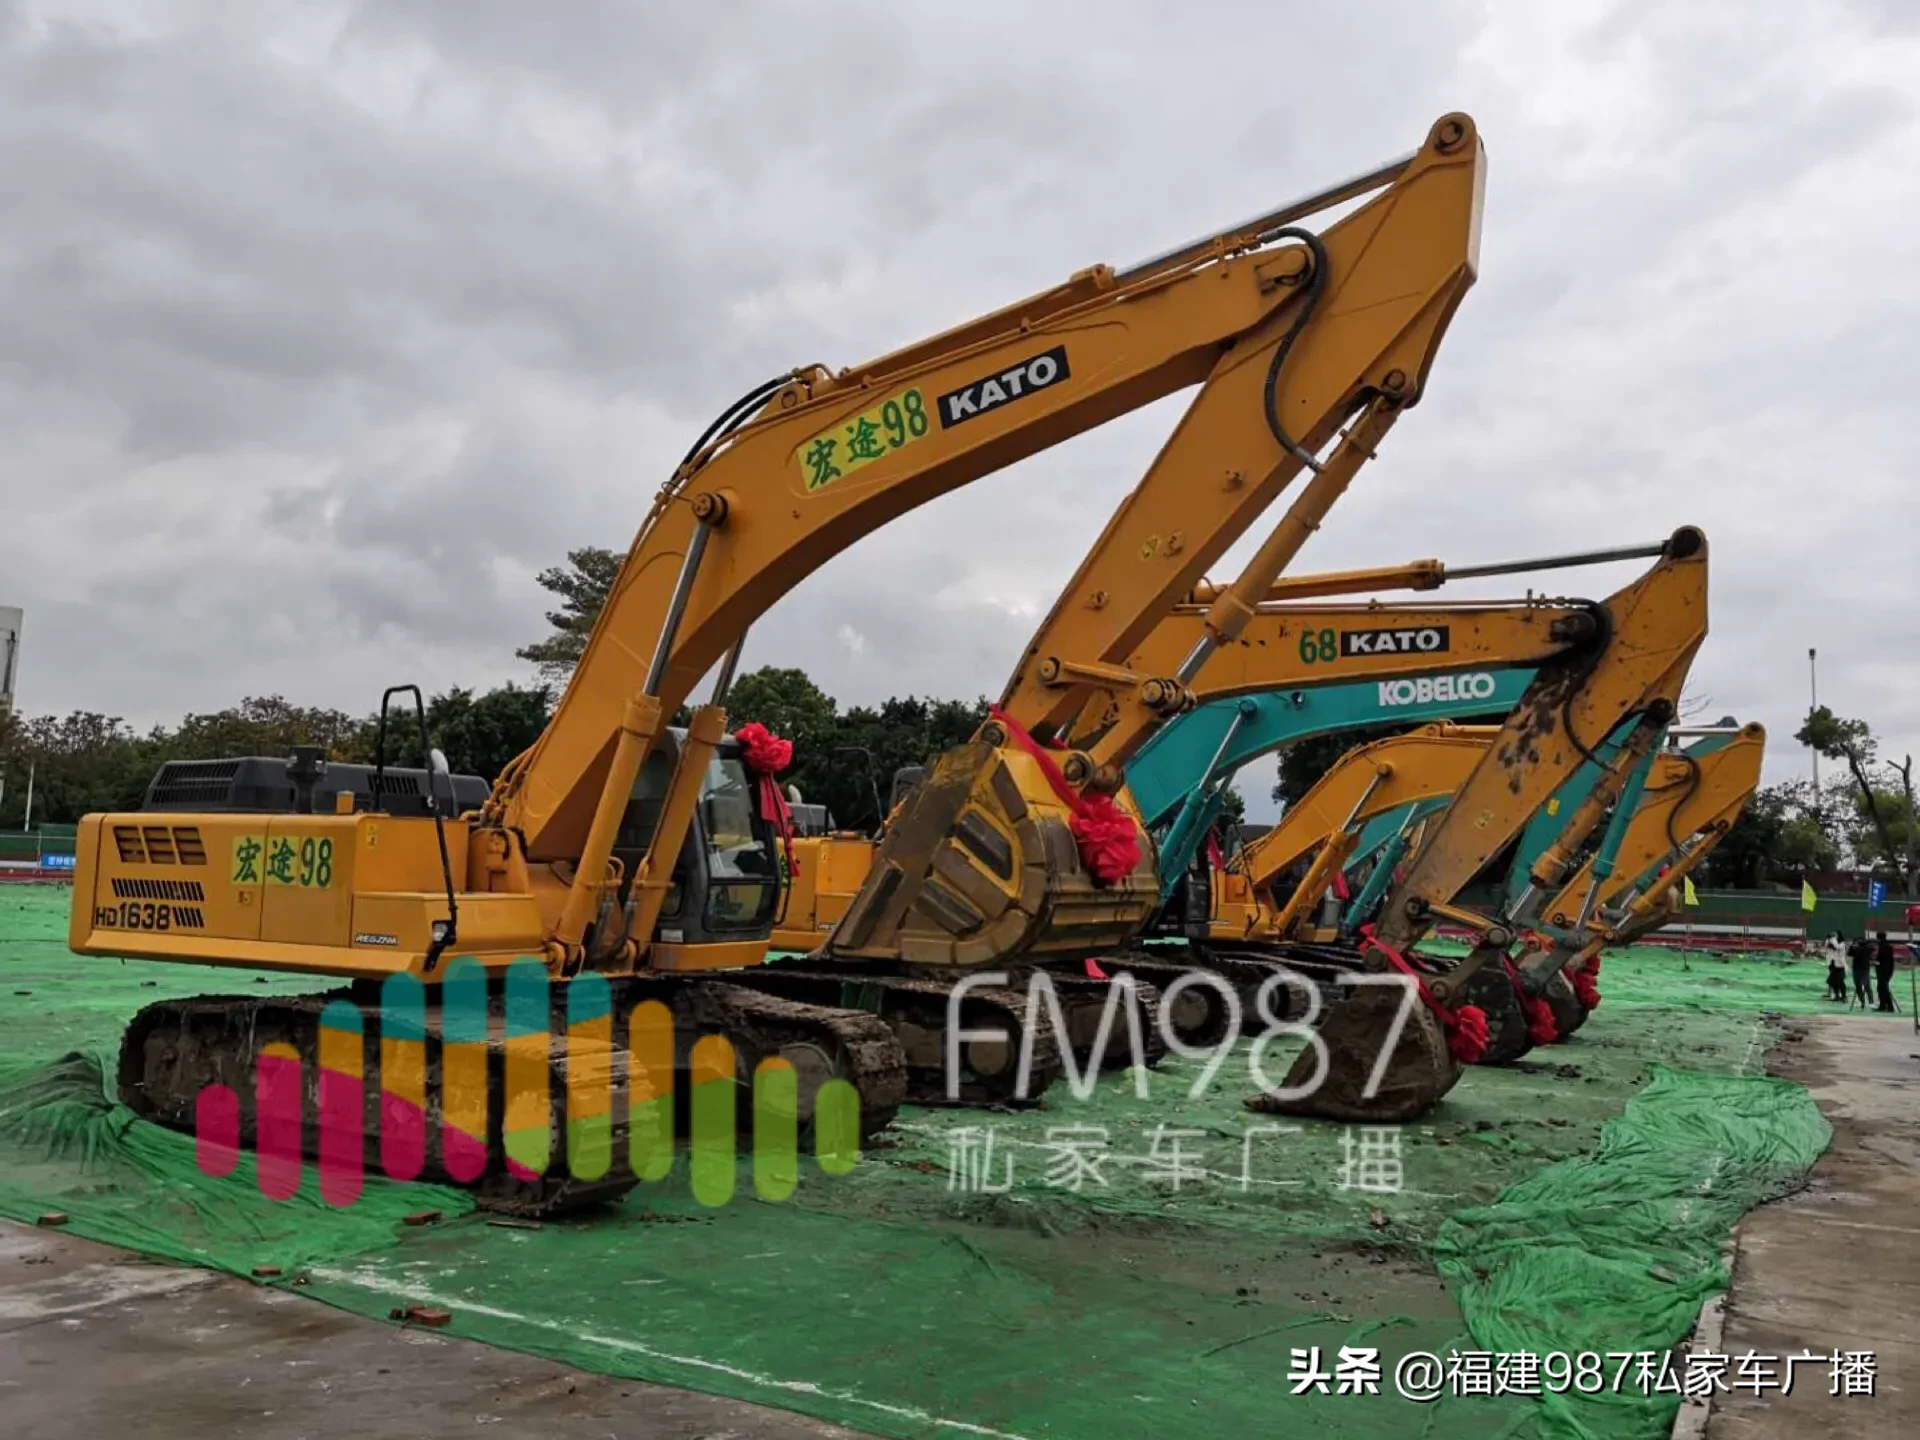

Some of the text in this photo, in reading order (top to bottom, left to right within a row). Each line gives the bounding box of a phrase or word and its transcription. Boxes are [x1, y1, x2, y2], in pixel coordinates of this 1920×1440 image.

[949, 355, 1058, 421] KATO
[805, 389, 929, 490] 宏途98
[1299, 628, 1441, 664] 68 KATO
[1378, 672, 1495, 706] KOBELCO
[233, 836, 333, 888] 宏途98
[95, 901, 170, 930] HD1638
